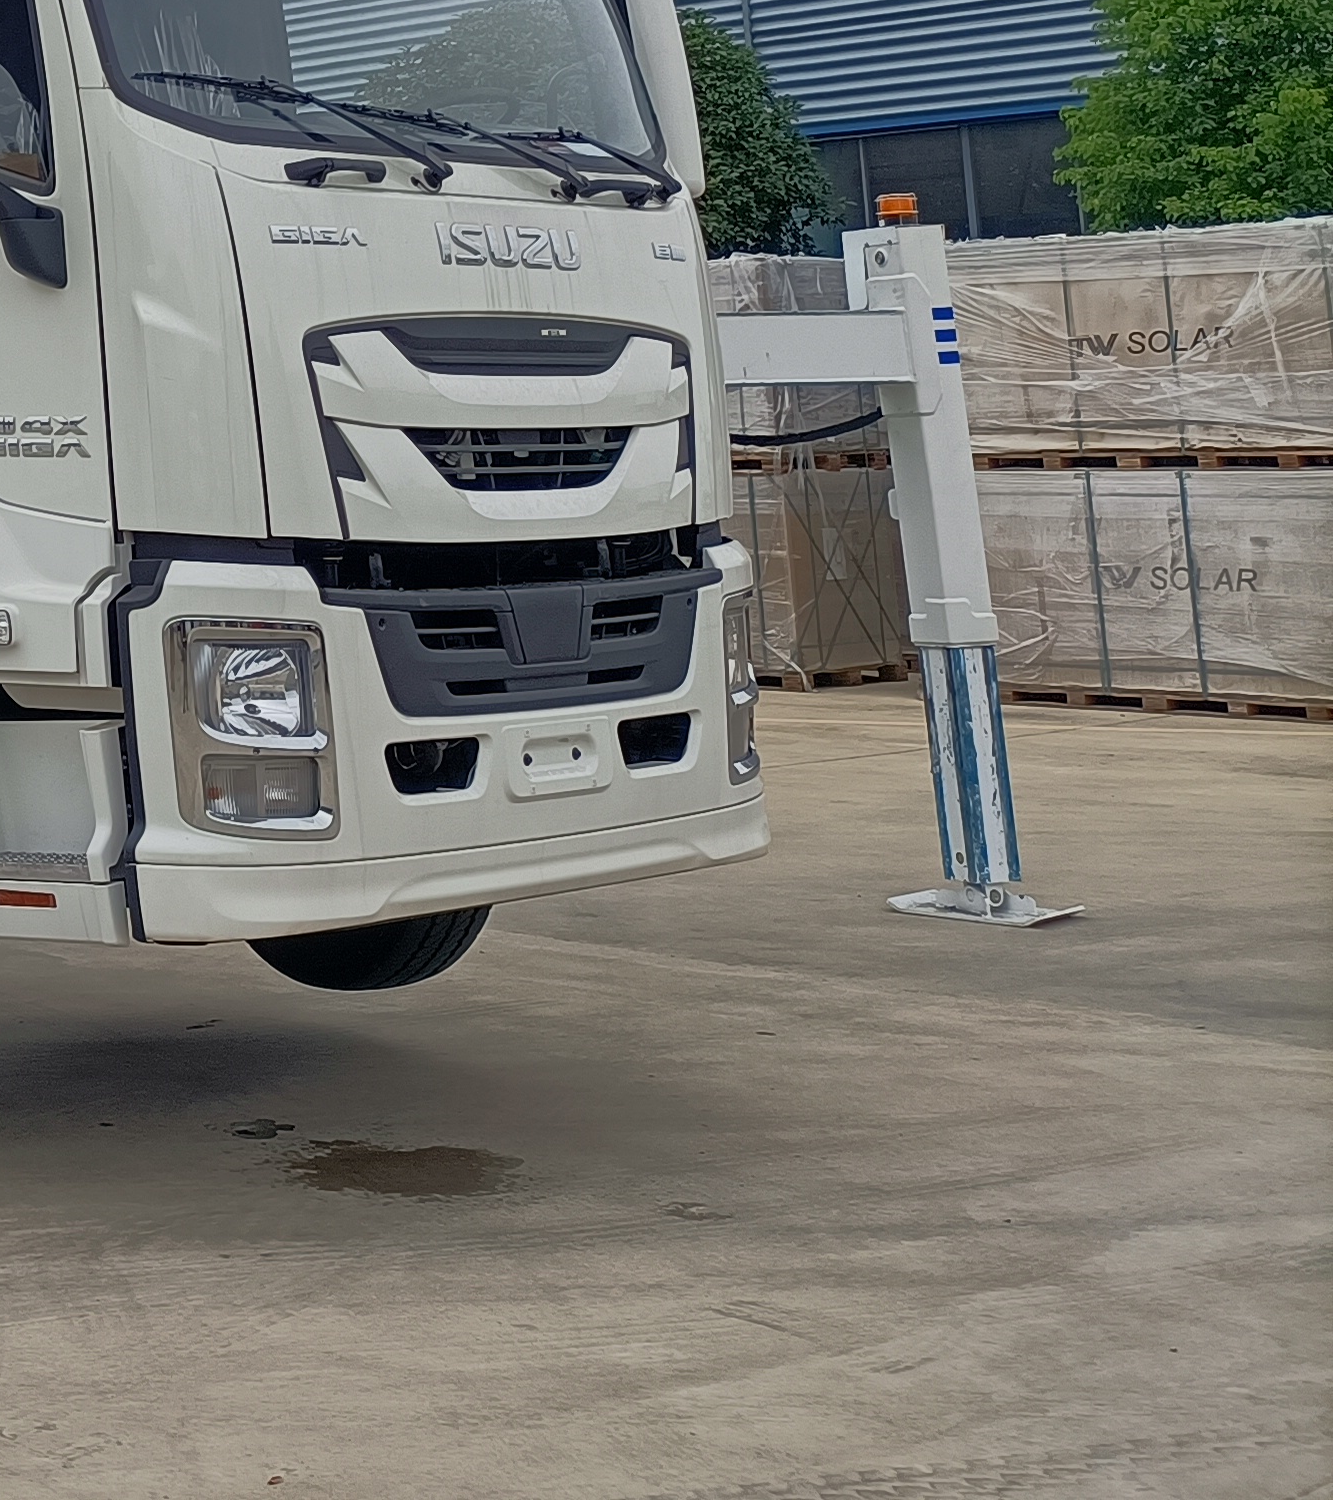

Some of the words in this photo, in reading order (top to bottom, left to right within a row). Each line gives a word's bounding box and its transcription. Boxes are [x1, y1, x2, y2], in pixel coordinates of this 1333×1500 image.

[269, 224, 367, 247] GIGA
[435, 221, 582, 271] ISUZU
[1126, 325, 1235, 355] SOLAR
[1150, 566, 1258, 592] SOLAR
